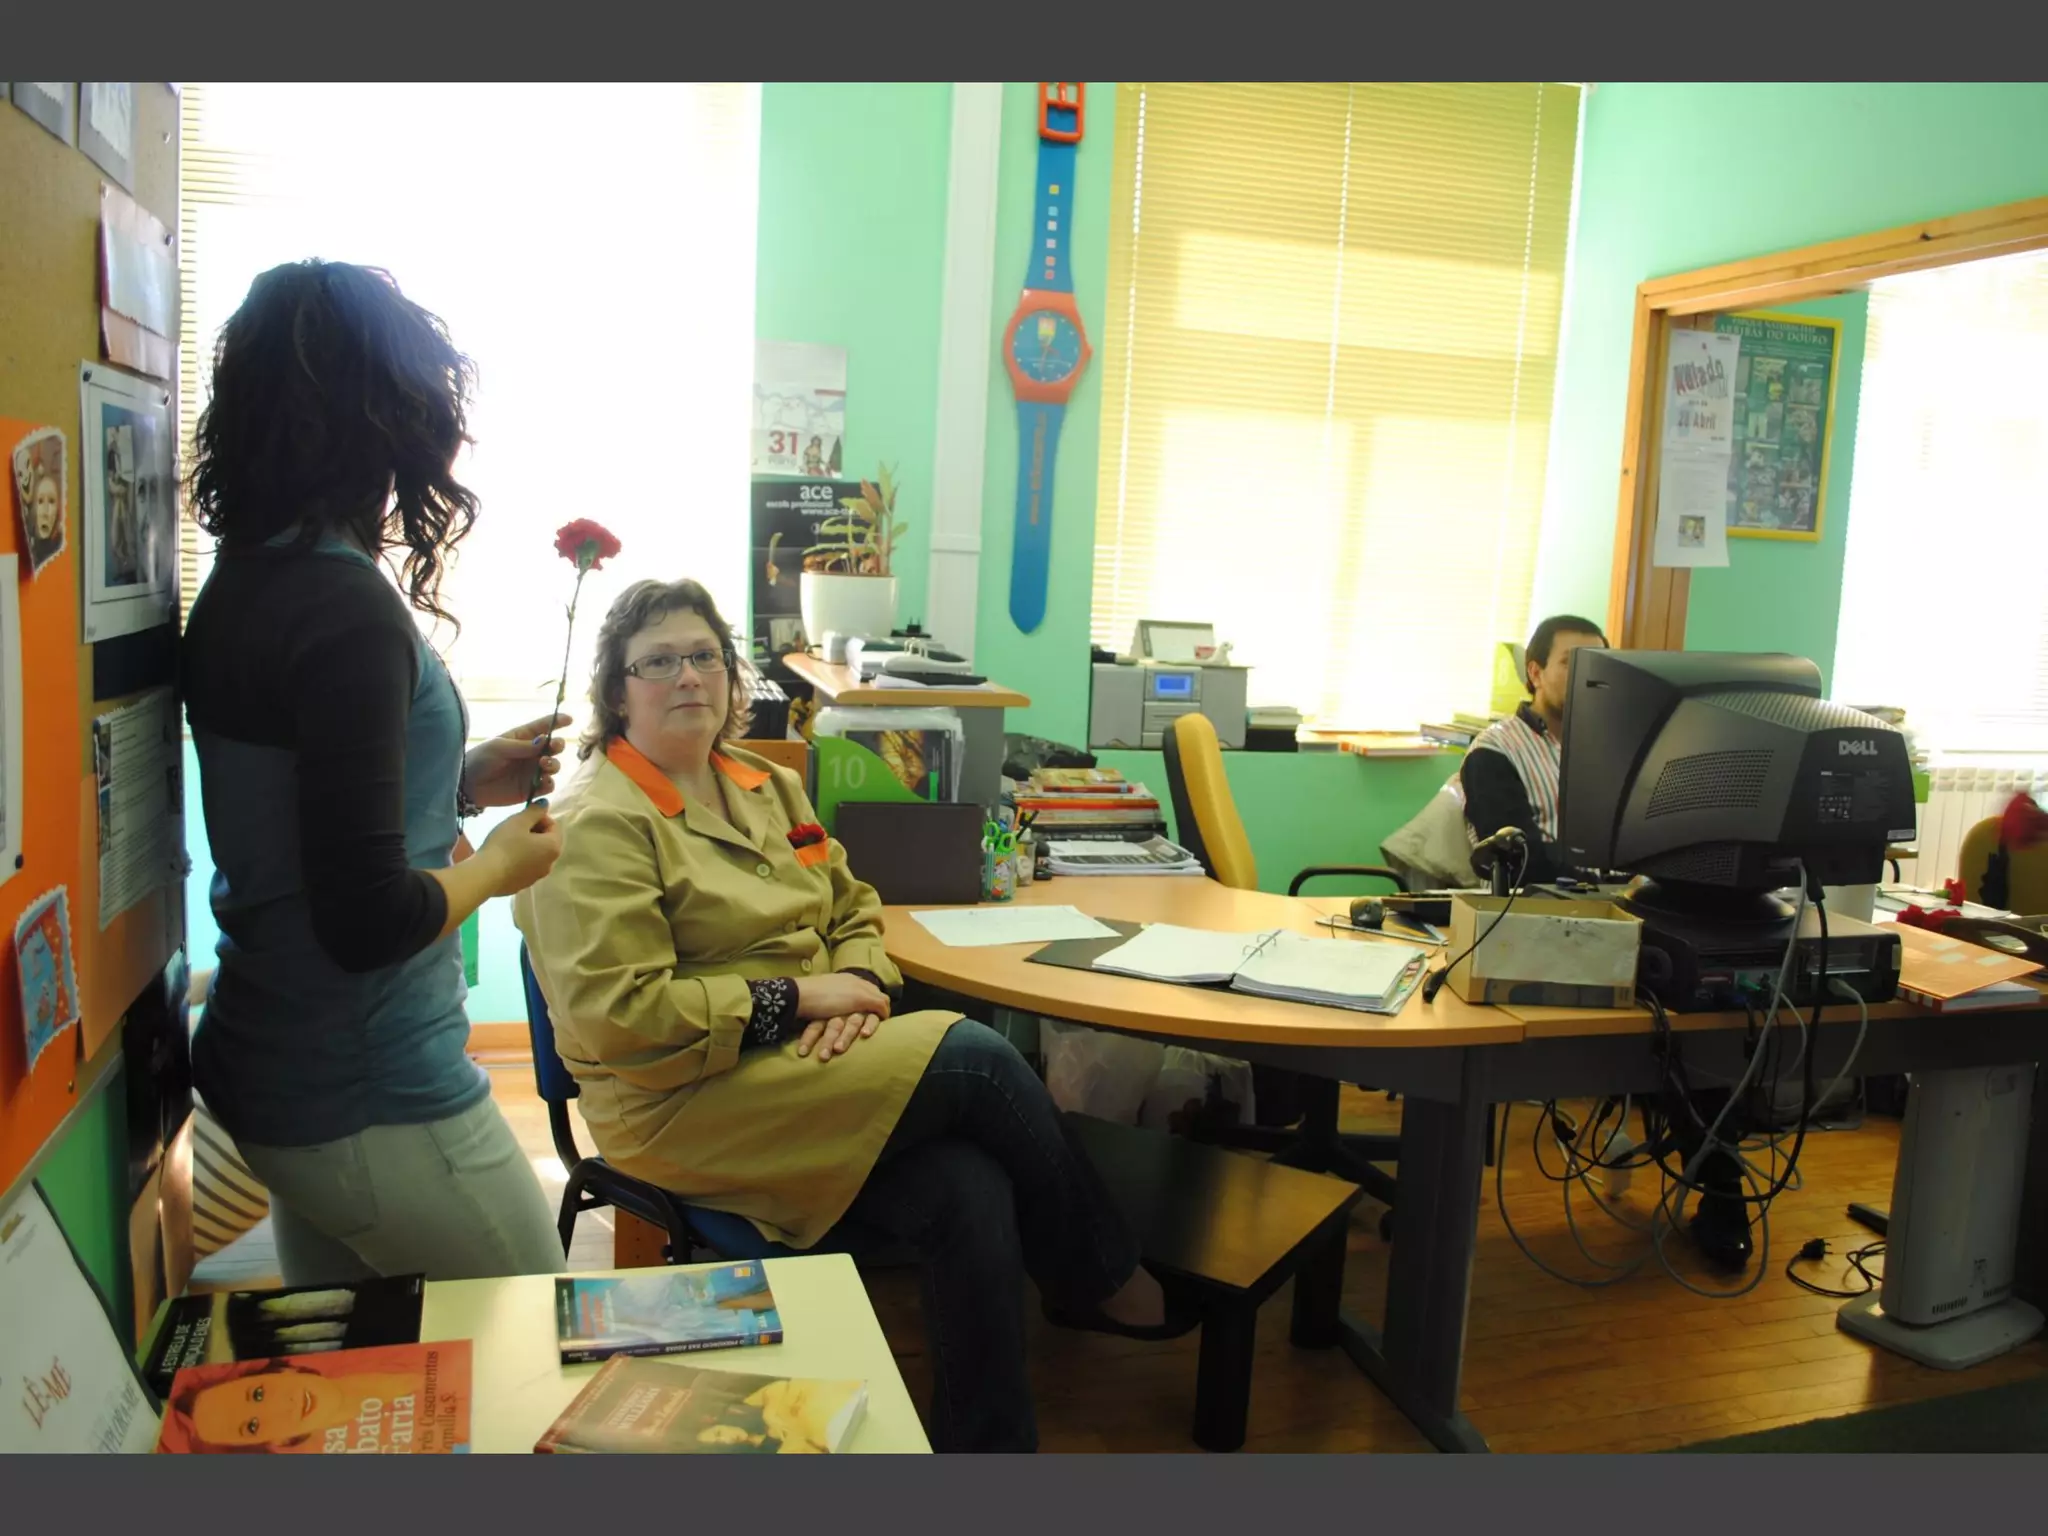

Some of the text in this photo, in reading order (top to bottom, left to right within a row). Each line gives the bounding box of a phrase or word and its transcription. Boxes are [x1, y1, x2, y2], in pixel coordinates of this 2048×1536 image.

[1787, 333, 1828, 345] DOURO
[768, 430, 799, 455] 31
[800, 485, 832, 499] ace
[1838, 740, 1878, 755] DELL
[828, 755, 866, 790] 10
[420, 1350, 438, 1427] Casamentos
[350, 1398, 382, 1454] bato
